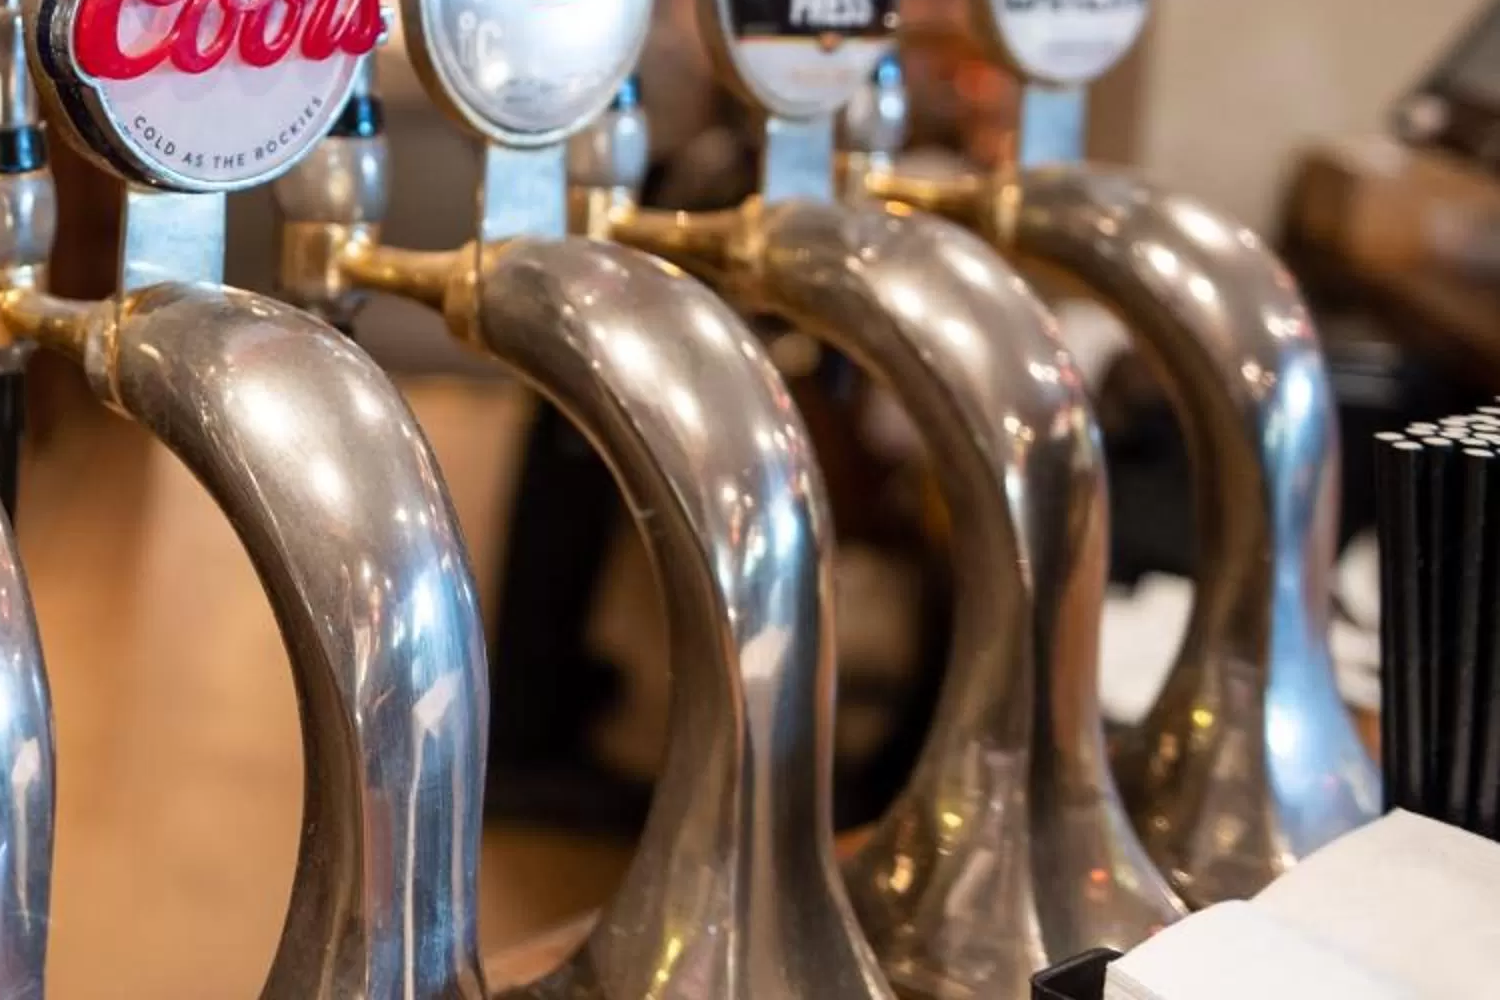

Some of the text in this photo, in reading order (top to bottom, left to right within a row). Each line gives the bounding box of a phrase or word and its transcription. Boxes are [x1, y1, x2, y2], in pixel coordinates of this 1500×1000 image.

[133, 96, 322, 169] COLD AS THE ROCKIES
